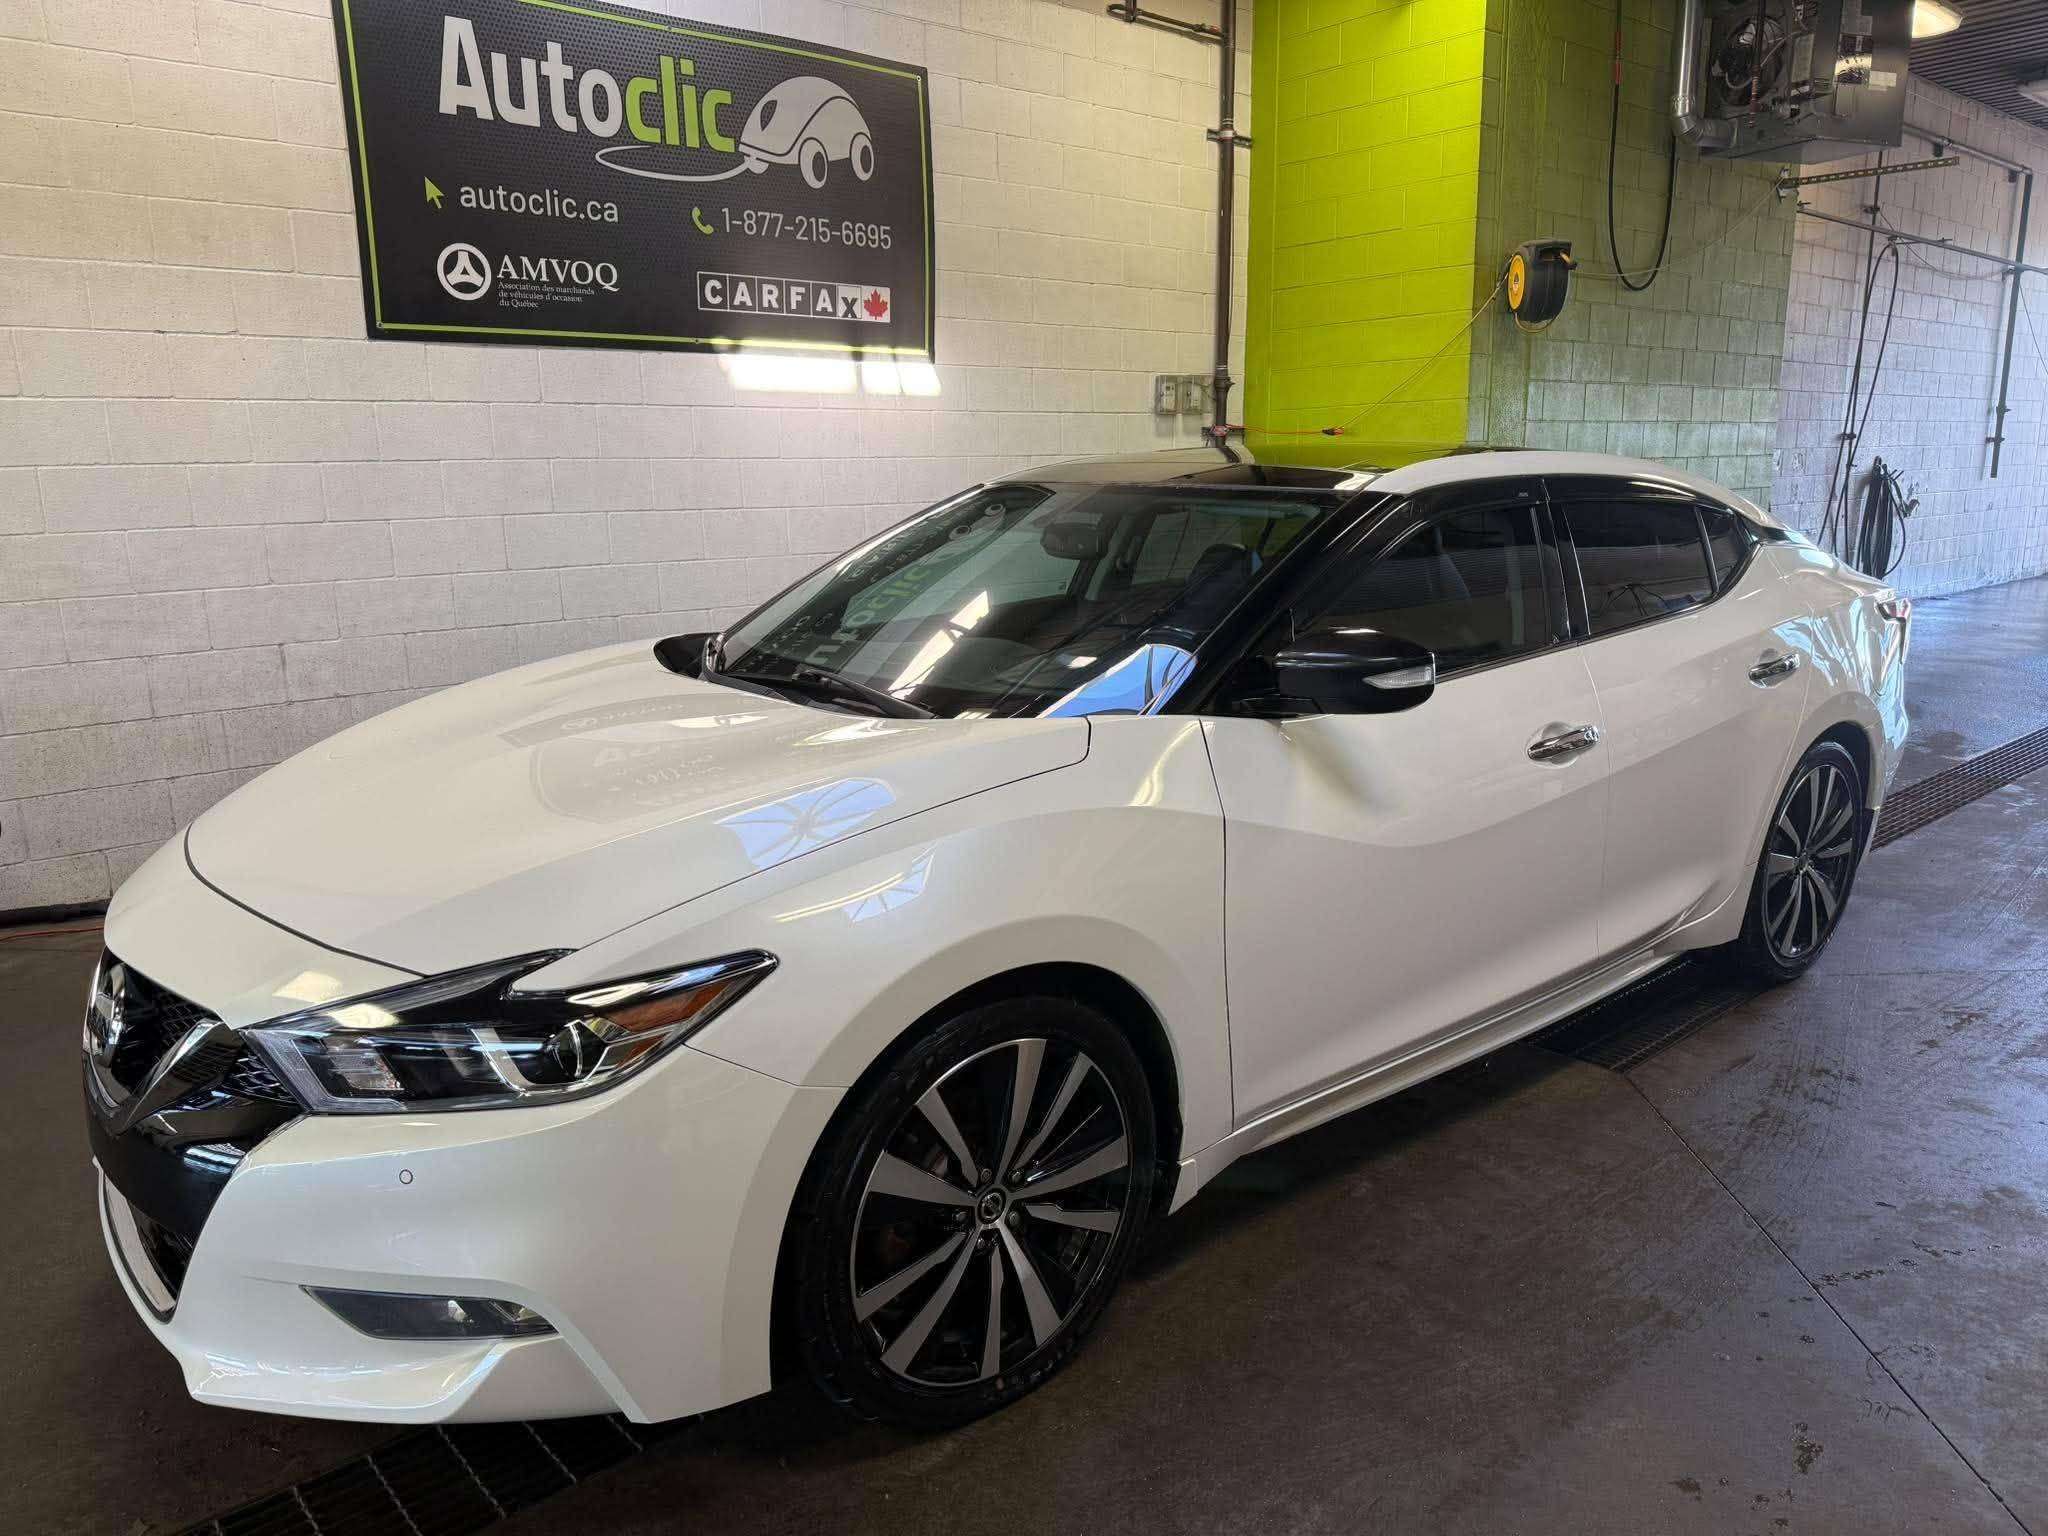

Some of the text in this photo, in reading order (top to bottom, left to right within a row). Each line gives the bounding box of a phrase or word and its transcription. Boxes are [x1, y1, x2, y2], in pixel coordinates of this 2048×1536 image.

[439, 15, 735, 153] Autoclic
[460, 185, 619, 223] autoclic.ca
[721, 207, 892, 249] 1-877-215-6695
[497, 254, 620, 292] AMVOQ
[498, 281, 595, 295] Association des marchands
[498, 289, 508, 298] de
[510, 290, 544, 300] véhicules
[499, 298, 539, 309] du Québec
[704, 279, 858, 319] CARFAX
